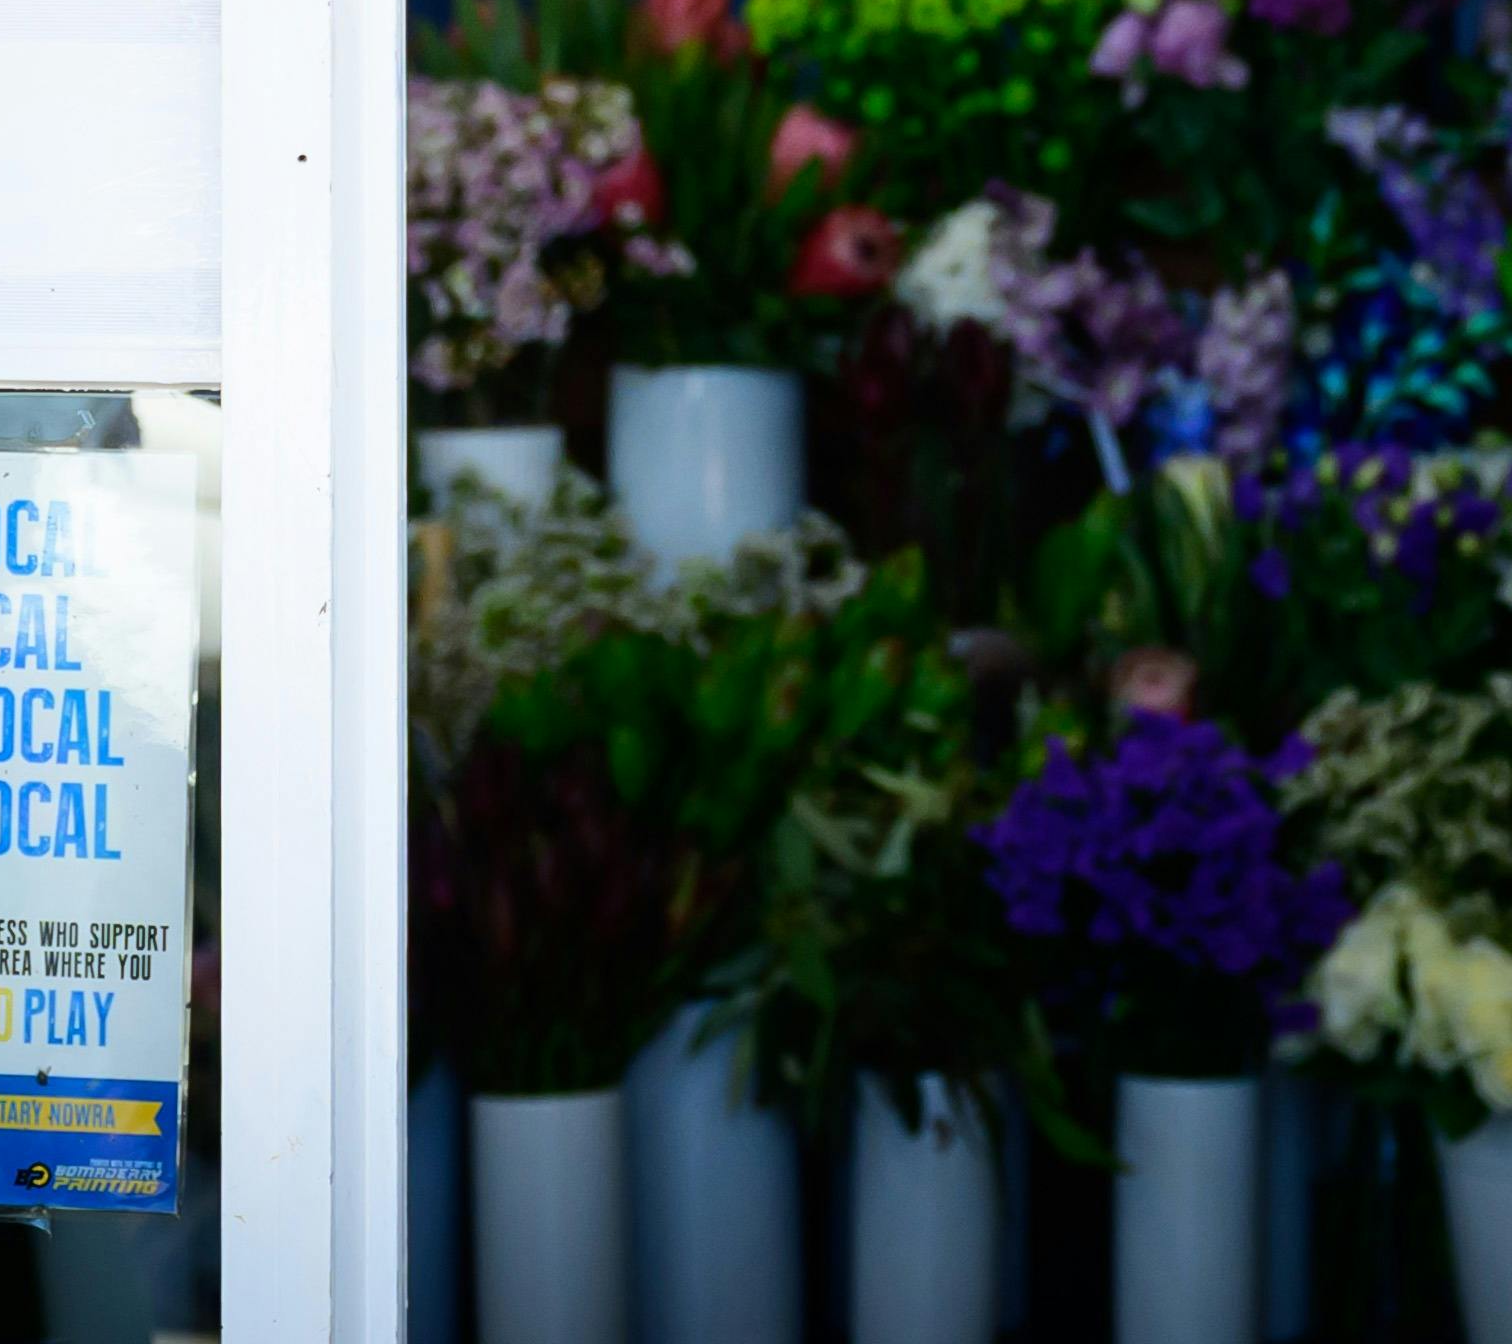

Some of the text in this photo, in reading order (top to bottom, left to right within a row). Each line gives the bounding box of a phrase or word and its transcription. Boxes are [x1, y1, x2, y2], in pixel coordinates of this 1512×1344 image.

[39, 921, 80, 950] WHO
[89, 922, 170, 953] SUPPORT
[44, 951, 106, 980] WHERE
[119, 954, 154, 981] YOU
[23, 988, 116, 1047] PLAY
[49, 1102, 117, 1129] NOWRA
[53, 1176, 160, 1196] PRINTING
[55, 1164, 163, 1181] BOMADERRY
